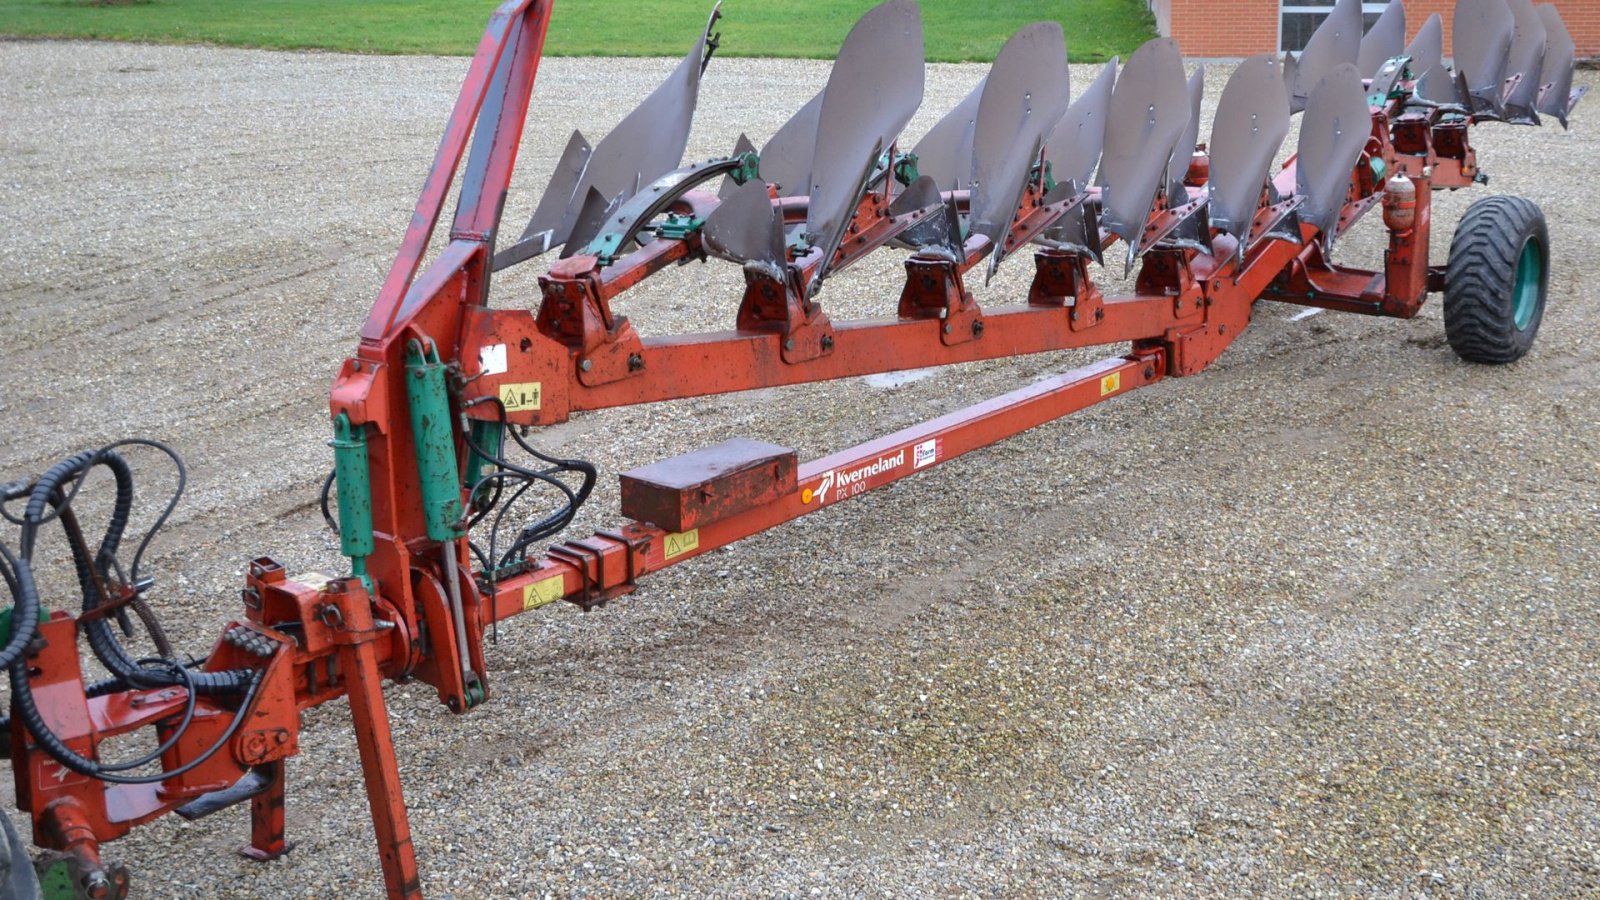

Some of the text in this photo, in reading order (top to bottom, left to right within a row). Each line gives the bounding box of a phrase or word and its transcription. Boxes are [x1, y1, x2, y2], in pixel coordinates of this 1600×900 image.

[836, 450, 904, 488] Kverneland
[836, 481, 866, 501] PX 100
